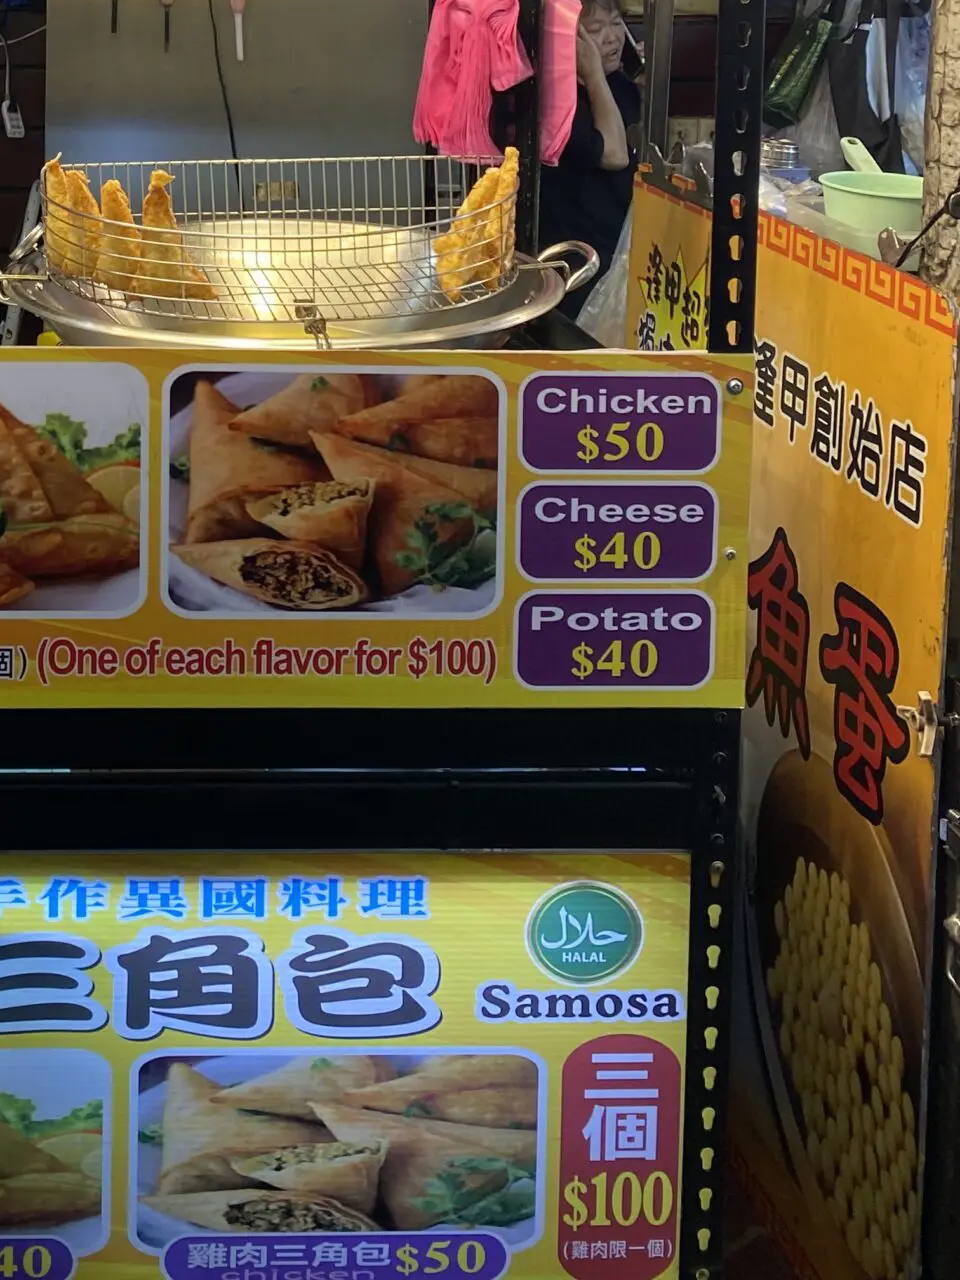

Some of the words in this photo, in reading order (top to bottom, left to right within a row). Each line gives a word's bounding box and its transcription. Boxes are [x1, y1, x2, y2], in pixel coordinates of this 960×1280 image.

[536, 386, 713, 416] Chicken
[576, 421, 665, 464] $50
[534, 496, 705, 526] Cheese
[573, 531, 662, 572] $40
[531, 605, 703, 633] Potato
[38, 637, 118, 685] (One
[125, 638, 162, 676] of
[165, 639, 246, 676] each
[253, 639, 349, 676] flavor
[354, 639, 402, 676] for
[407, 637, 496, 685] $100)
[570, 639, 658, 680] $40
[541, 905, 628, 949] حلال
[562, 951, 607, 963] HALAL
[481, 984, 680, 1019] Samosa
[581, 1052, 660, 1161] 三個
[562, 1171, 674, 1232] $100
[187, 1242, 392, 1269] 雞肉三角包
[395, 1240, 487, 1277] $50
[562, 1239, 674, 1261] (雞肉限一個)
